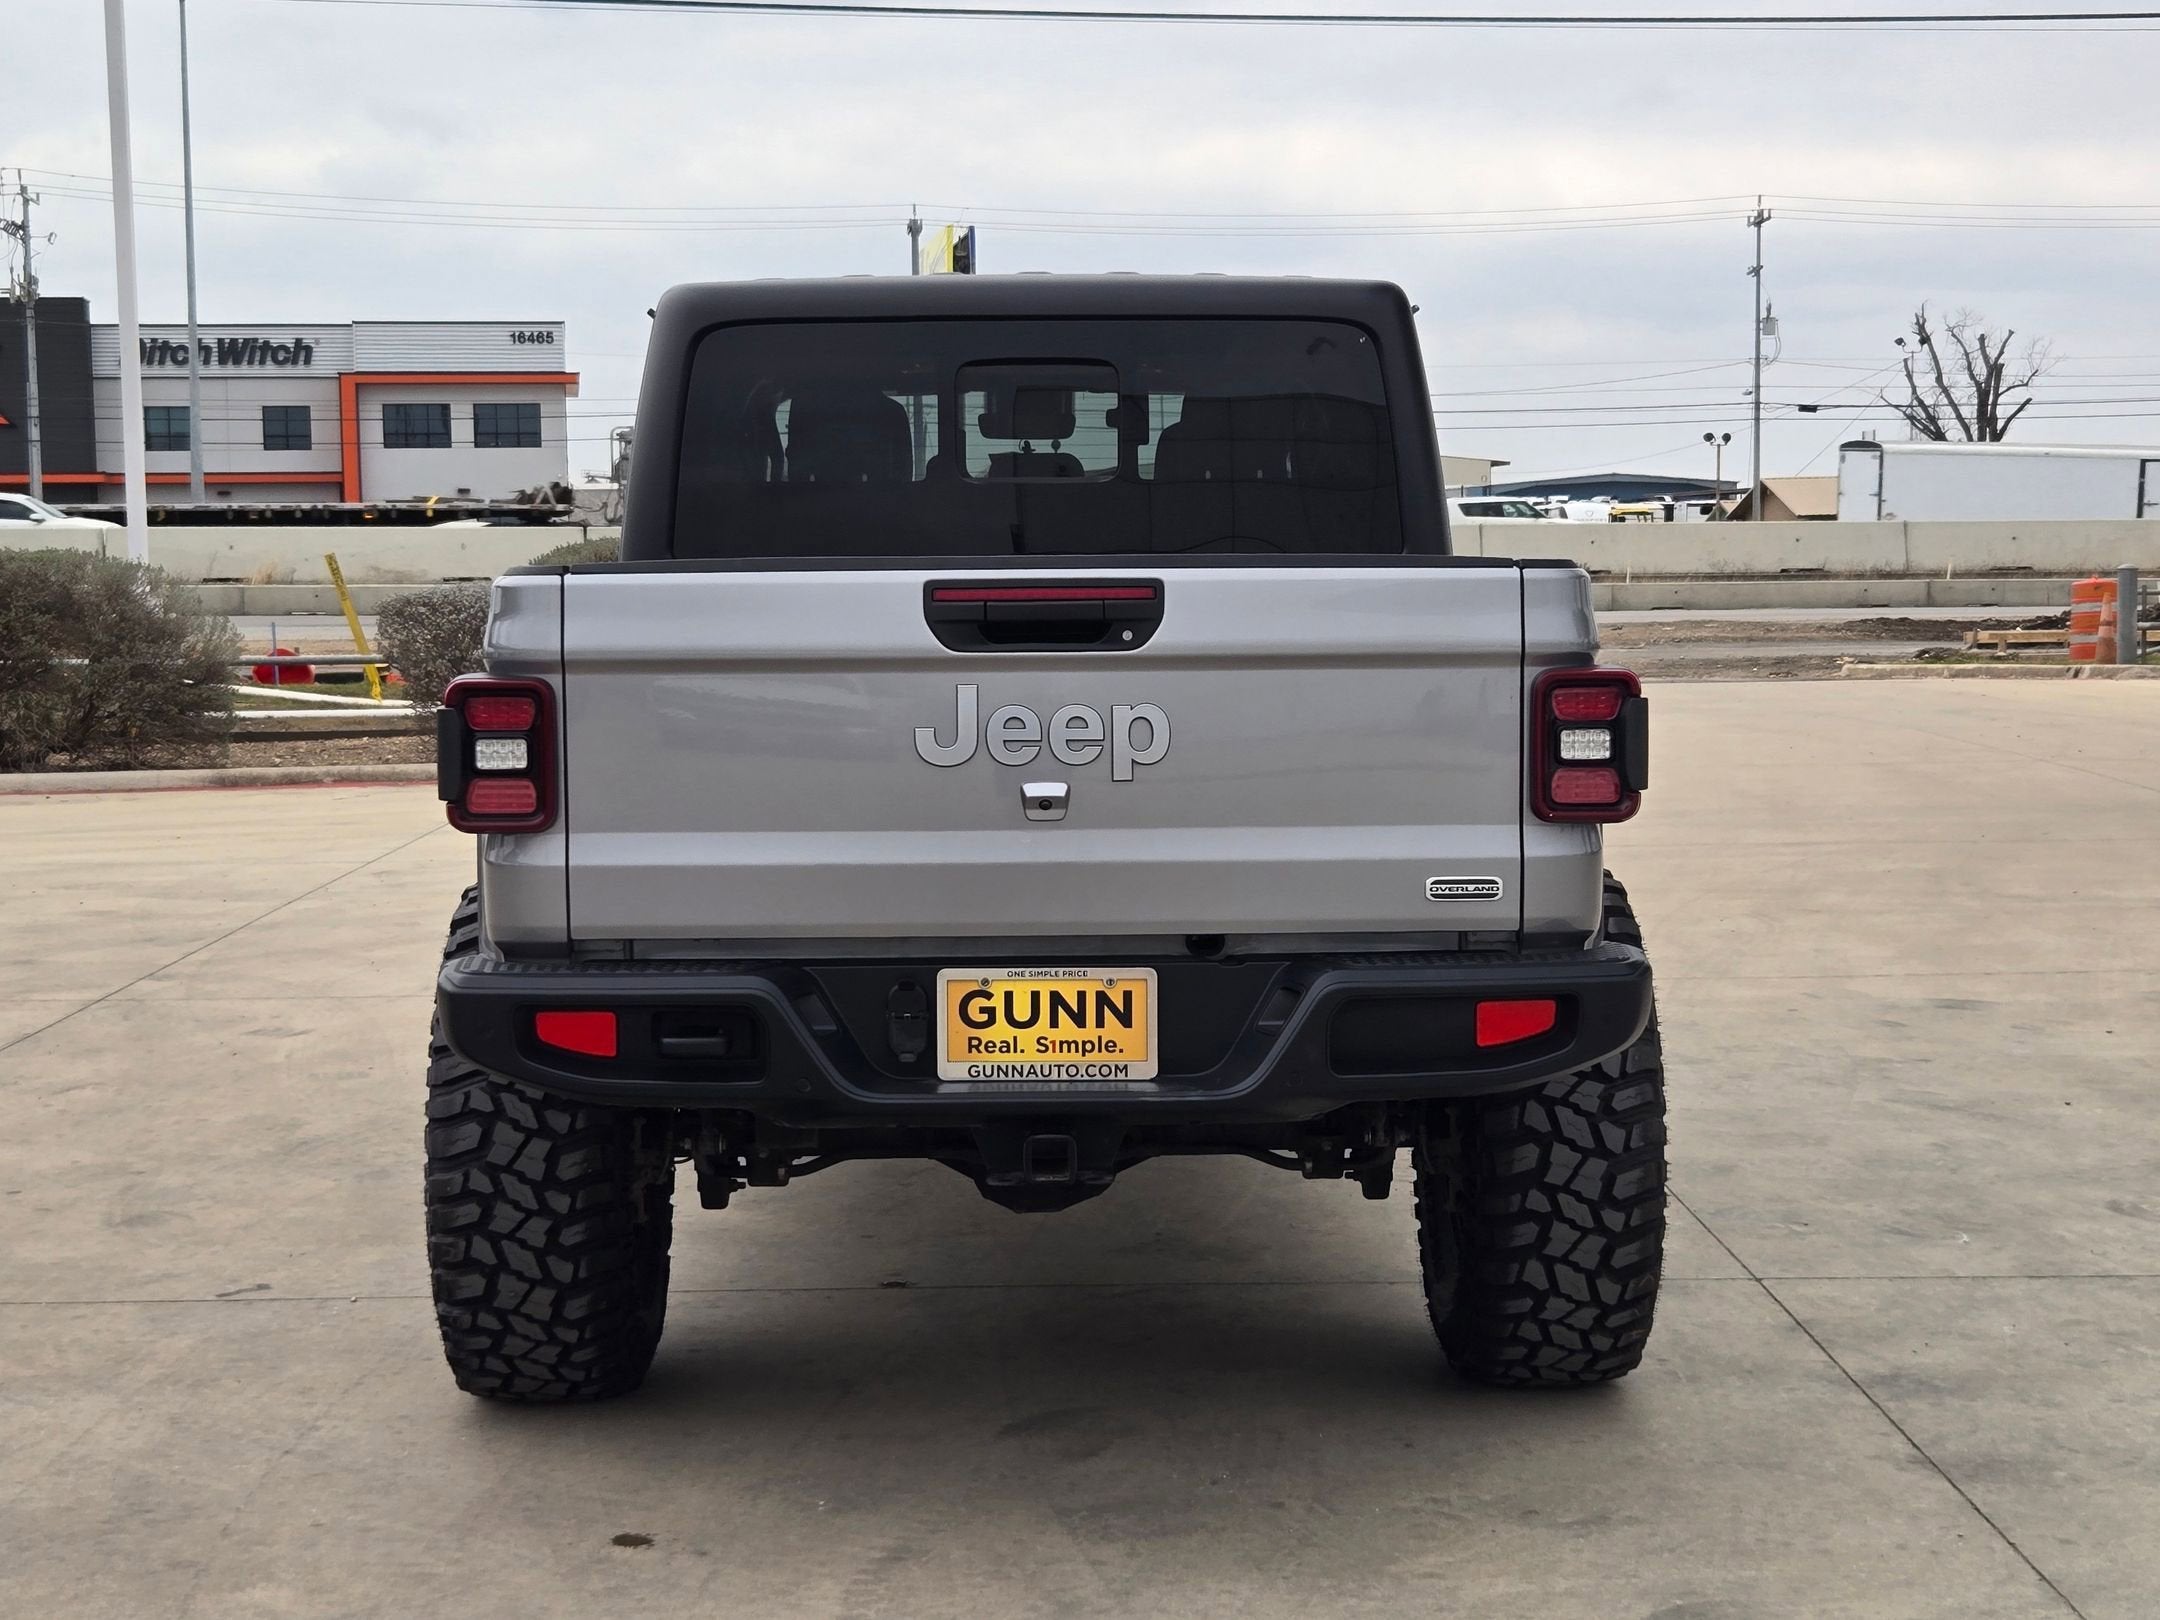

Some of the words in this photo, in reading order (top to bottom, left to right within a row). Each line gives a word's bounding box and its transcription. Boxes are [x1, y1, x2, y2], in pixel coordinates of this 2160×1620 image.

[510, 331, 554, 344] 16465
[217, 338, 314, 366] Witch
[914, 684, 1171, 782] Jeep
[1006, 970, 1026, 978] ONE
[1028, 970, 1060, 978] SIMPLE
[1062, 970, 1088, 978] PRICE
[958, 989, 1133, 1030] GUNN
[967, 1036, 1025, 1054] Real.
[967, 1064, 1129, 1078] GUNNAUTO.COM
